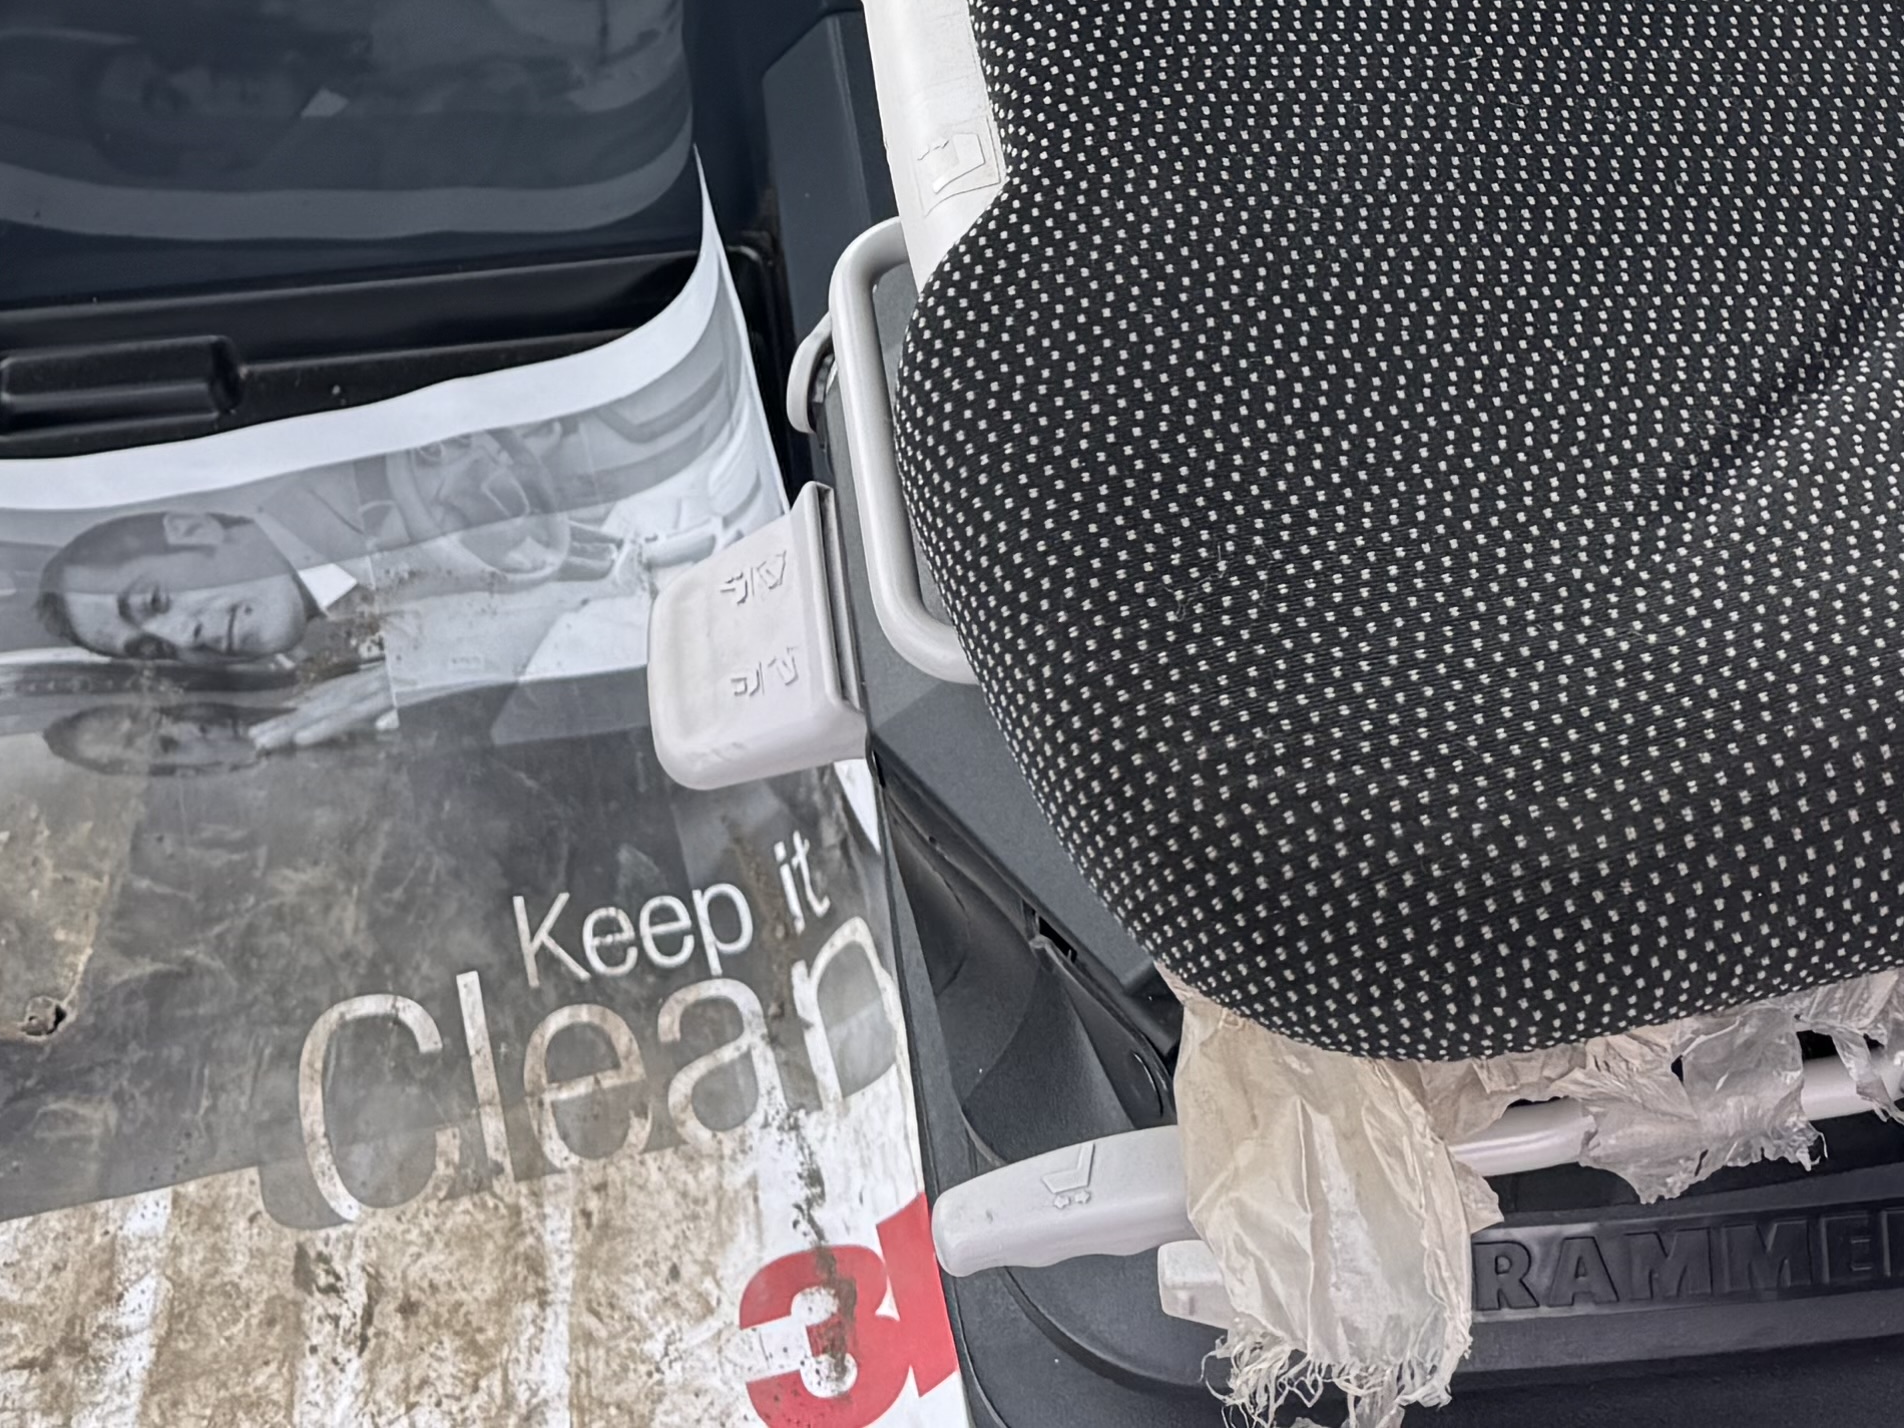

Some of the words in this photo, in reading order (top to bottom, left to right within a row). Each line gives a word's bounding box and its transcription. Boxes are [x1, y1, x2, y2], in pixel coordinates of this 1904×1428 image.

[512, 881, 755, 989] Keep
[773, 830, 831, 933] it
[298, 915, 901, 1225] Clean
